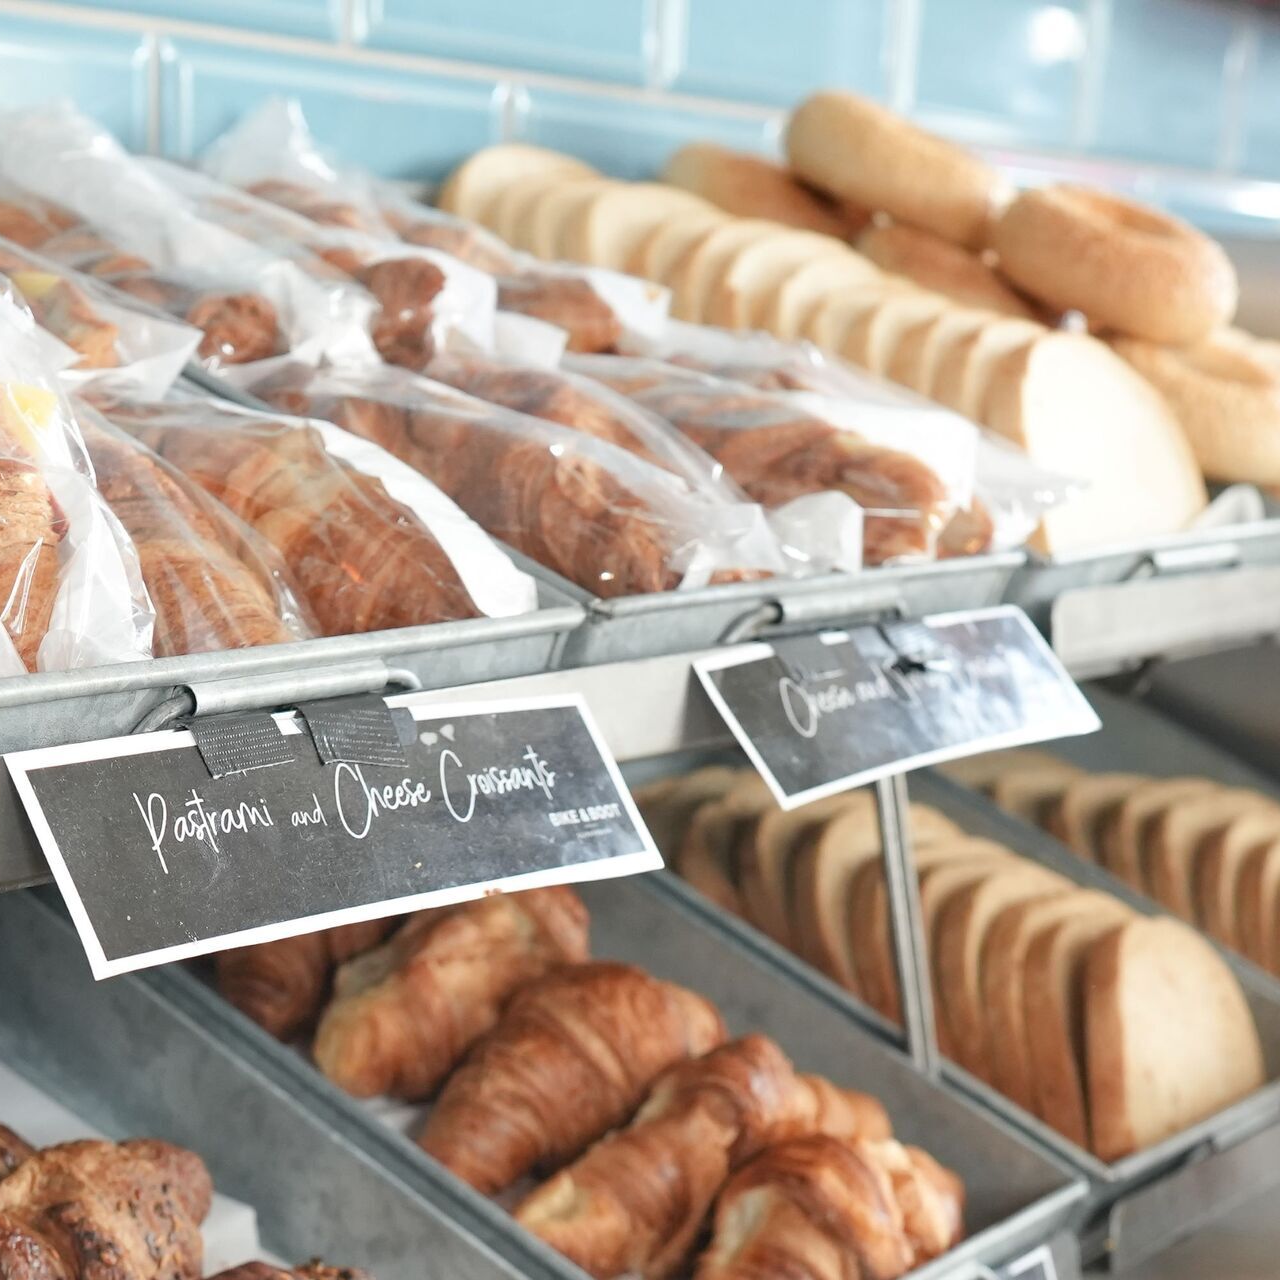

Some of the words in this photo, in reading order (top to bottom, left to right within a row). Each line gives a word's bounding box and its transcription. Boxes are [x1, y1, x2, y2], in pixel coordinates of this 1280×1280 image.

[133, 789, 273, 874] Pastrami
[291, 793, 328, 826] and
[334, 763, 431, 839] Cheese
[439, 744, 556, 822] Croissants
